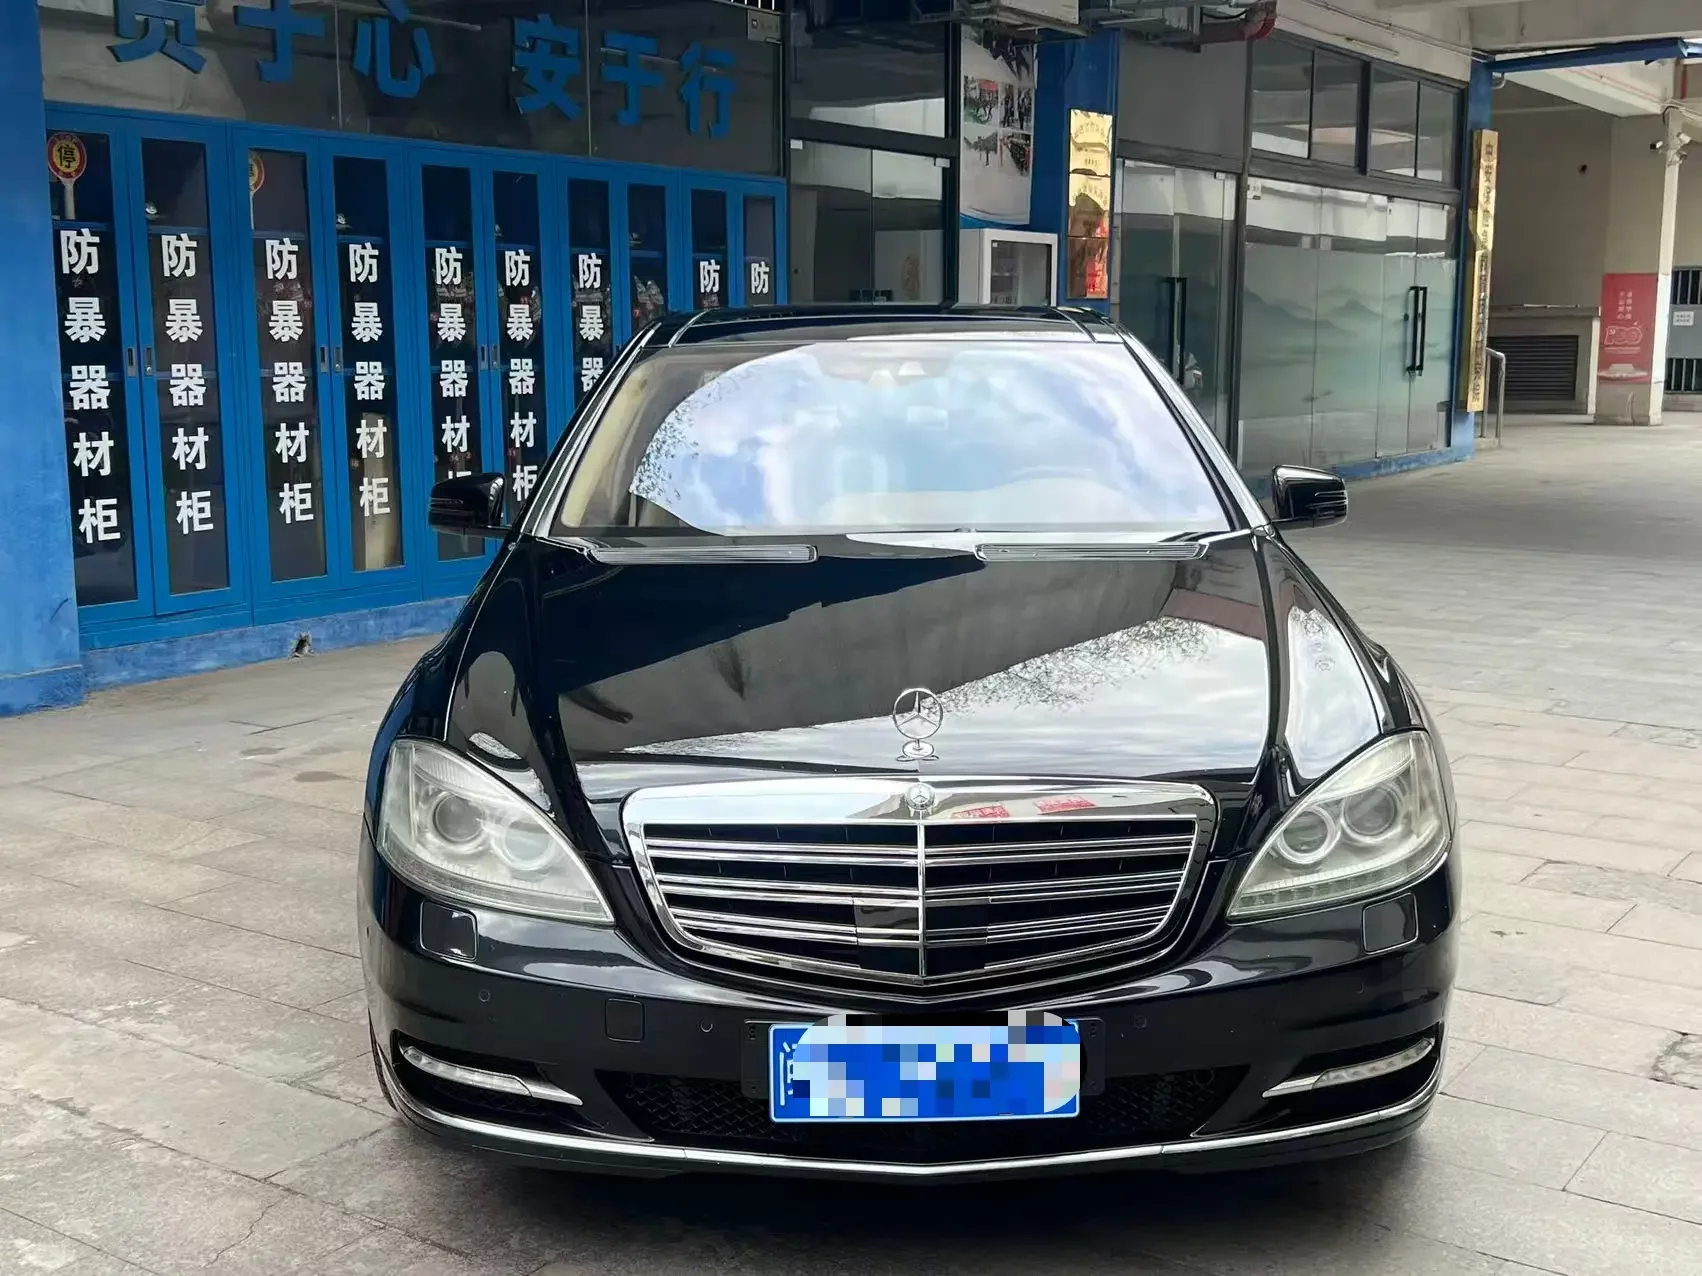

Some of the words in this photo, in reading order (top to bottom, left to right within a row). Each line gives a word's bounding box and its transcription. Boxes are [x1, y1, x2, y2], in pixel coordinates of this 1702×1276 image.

[57, 144, 77, 169] 停
[512, 13, 737, 139] 安于行
[60, 228, 121, 544] 防暴器材柜
[161, 233, 214, 535] 防暴器材柜
[265, 237, 314, 524] 防暴器材柜
[349, 242, 391, 517] 防暴器材柜
[435, 246, 472, 479] 防暴器材
[699, 259, 721, 294] 防
[751, 261, 770, 294] 防
